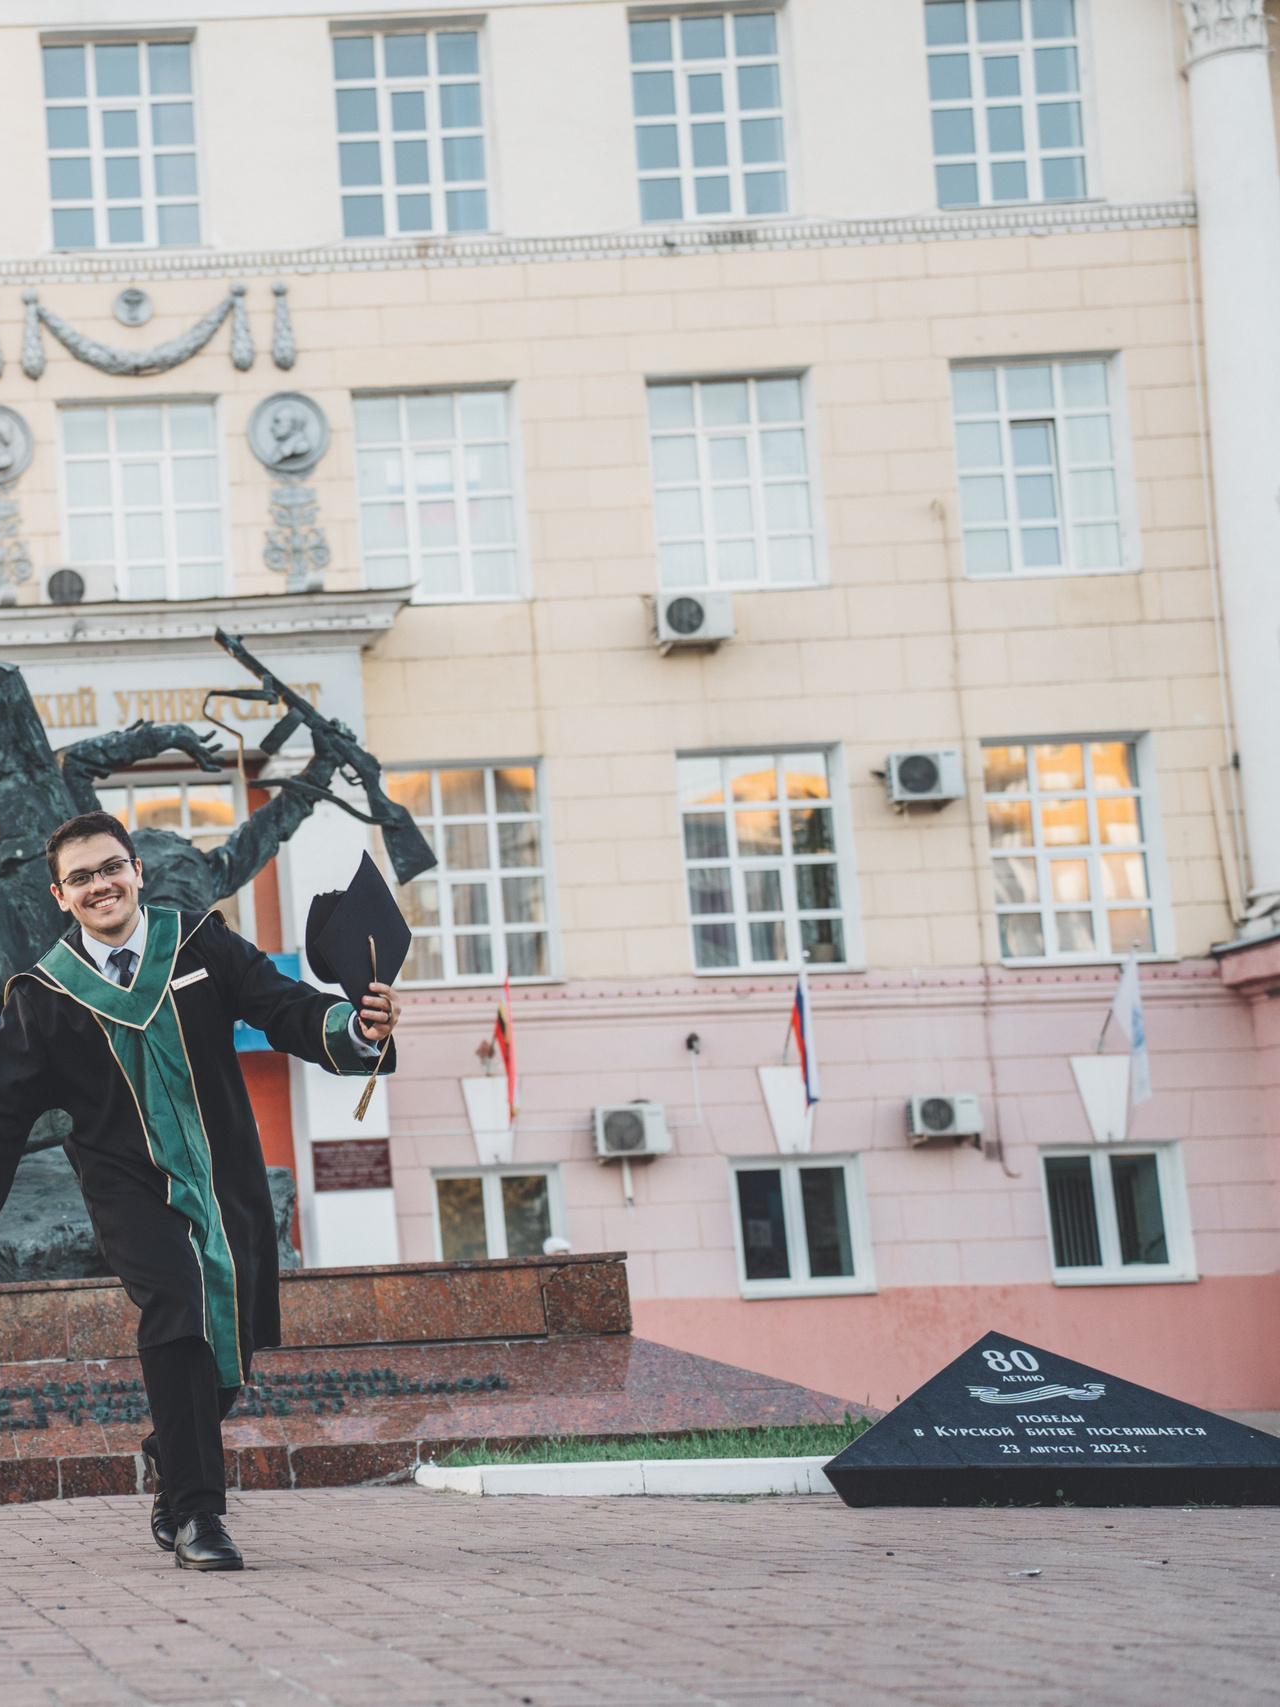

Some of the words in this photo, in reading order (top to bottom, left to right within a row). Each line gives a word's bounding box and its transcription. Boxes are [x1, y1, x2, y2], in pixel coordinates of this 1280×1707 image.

[982, 1350, 1039, 1372] 80
[1002, 1374, 1045, 1383] ЛЕТИЮ
[1016, 1414, 1085, 1423] ПОБЕДЫ
[913, 1428, 925, 1437] В
[1025, 1427, 1077, 1437] БИТВЕ
[1085, 1427, 1207, 1437] ПОСВЯЩАЕТСЯ
[999, 1444, 1020, 1454] 23
[1030, 1445, 1085, 1454] АВГУСТА
[1089, 1443, 1131, 1453] 2023
